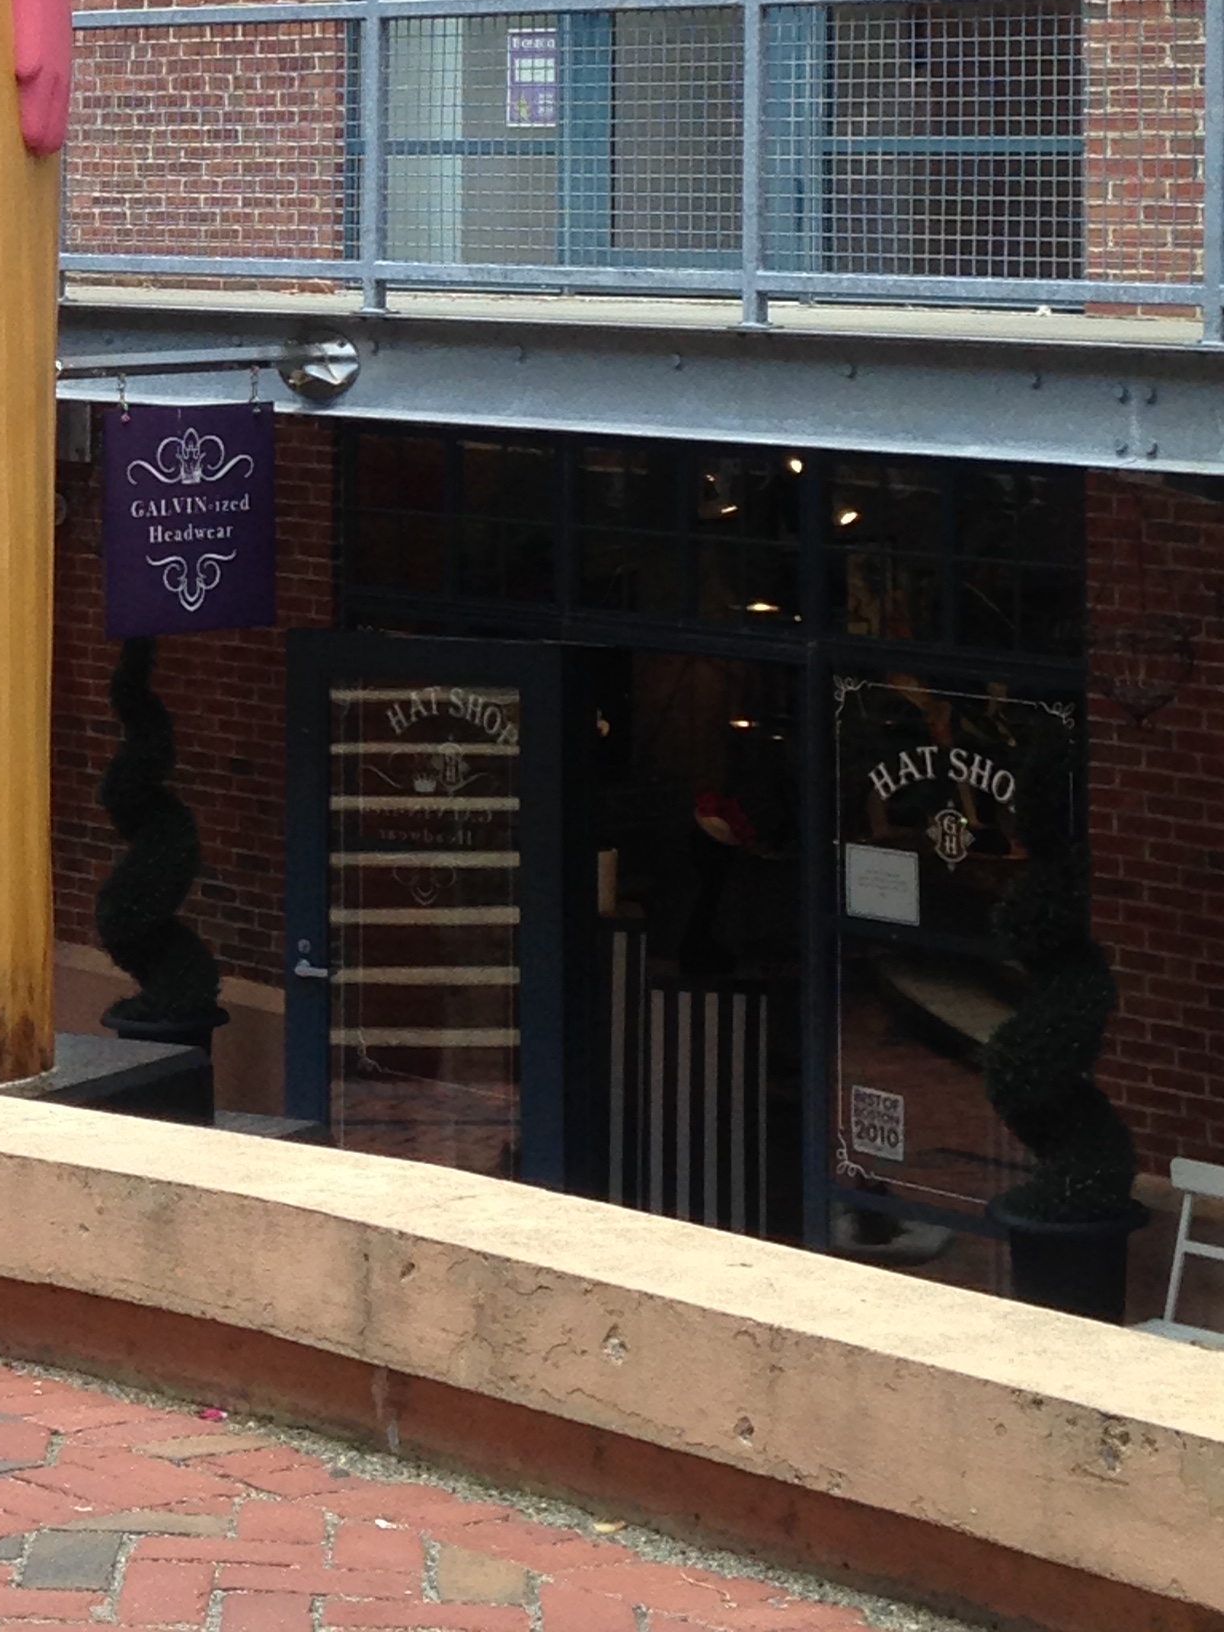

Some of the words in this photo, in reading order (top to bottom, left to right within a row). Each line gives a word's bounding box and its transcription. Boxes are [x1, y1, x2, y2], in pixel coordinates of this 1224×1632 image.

[130, 494, 251, 518] GALVIN-ized
[148, 524, 234, 544] Headwear
[386, 686, 441, 736] HAT
[868, 745, 939, 801] HAT
[948, 747, 1017, 814] SHO
[855, 1120, 900, 1149] 2010
